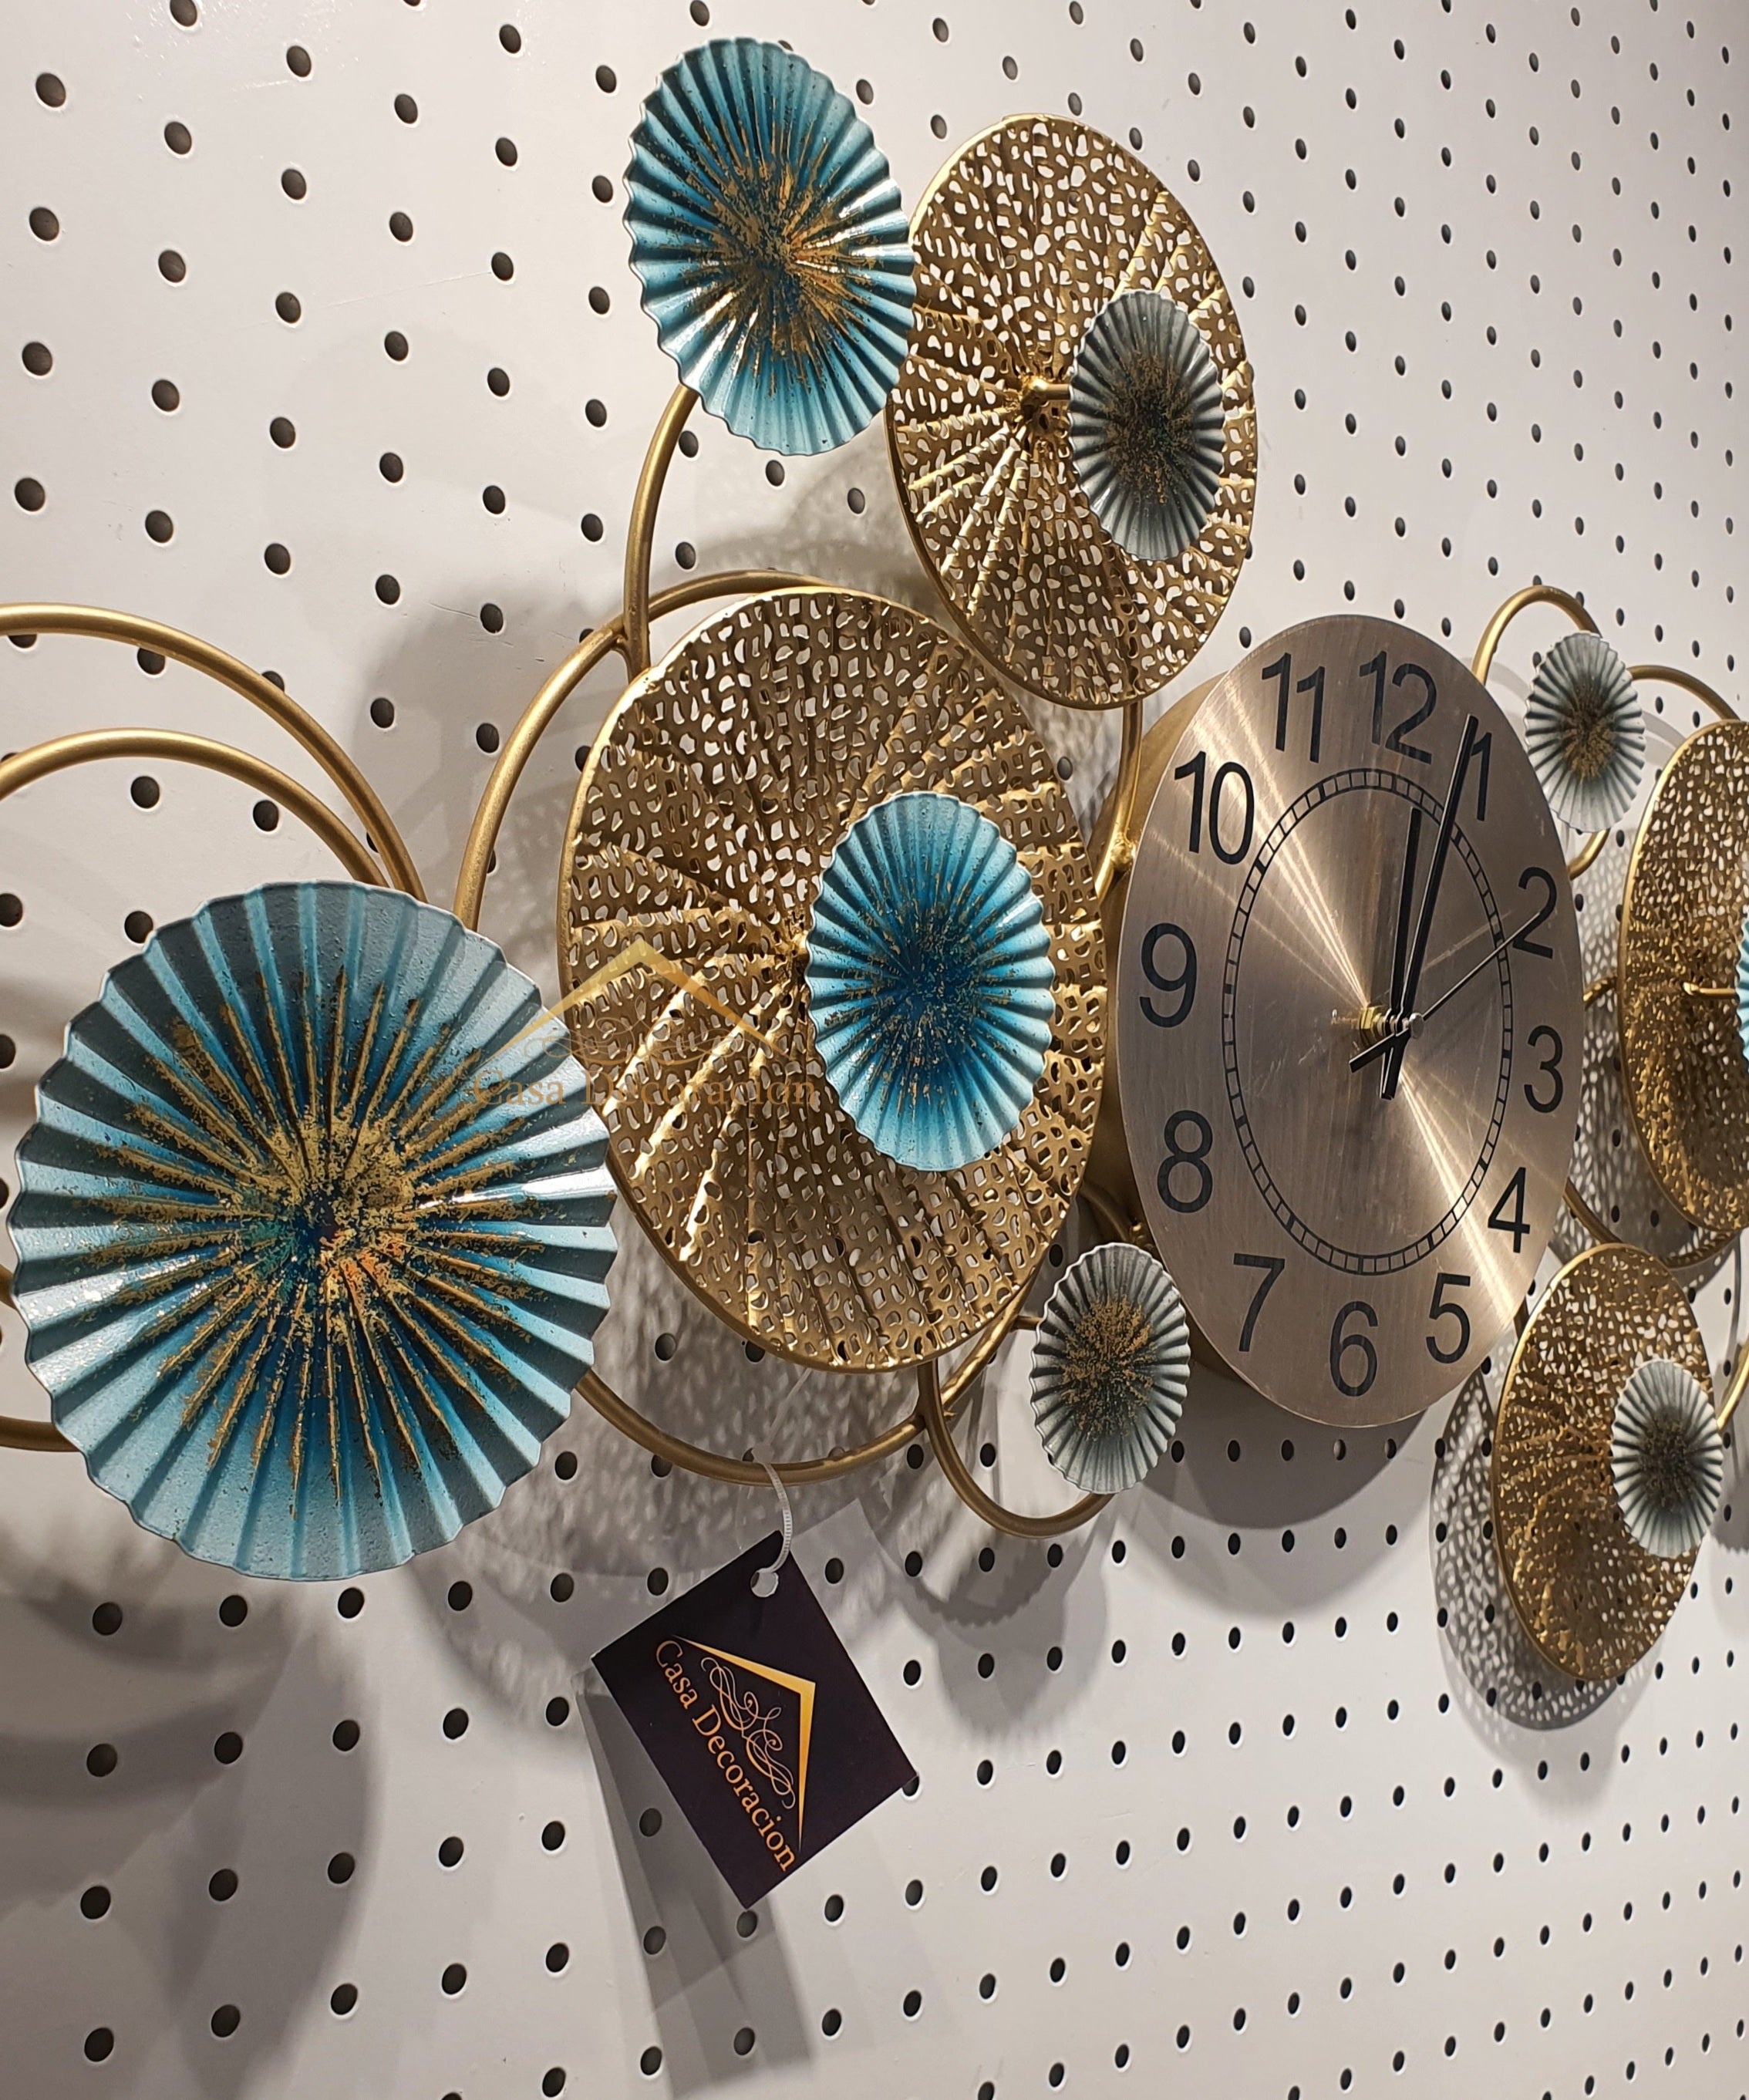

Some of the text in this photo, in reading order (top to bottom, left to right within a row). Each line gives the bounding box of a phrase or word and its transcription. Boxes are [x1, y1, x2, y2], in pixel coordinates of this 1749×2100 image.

[1261, 652, 1325, 763] 11
[1359, 650, 1437, 763] 12
[1174, 750, 1255, 865] 10
[1469, 732, 1493, 821] 1
[1513, 867, 1557, 959] 2
[1139, 923, 1197, 1027] 9
[1524, 1024, 1563, 1112] 3
[1157, 1110, 1213, 1213] 8
[1488, 1166, 1530, 1253] 4
[1234, 1252, 1286, 1352] 7
[1329, 1300, 1379, 1397] 6
[1426, 1272, 1471, 1363] 5
[655, 1640, 797, 1872] Casa Decoracion
